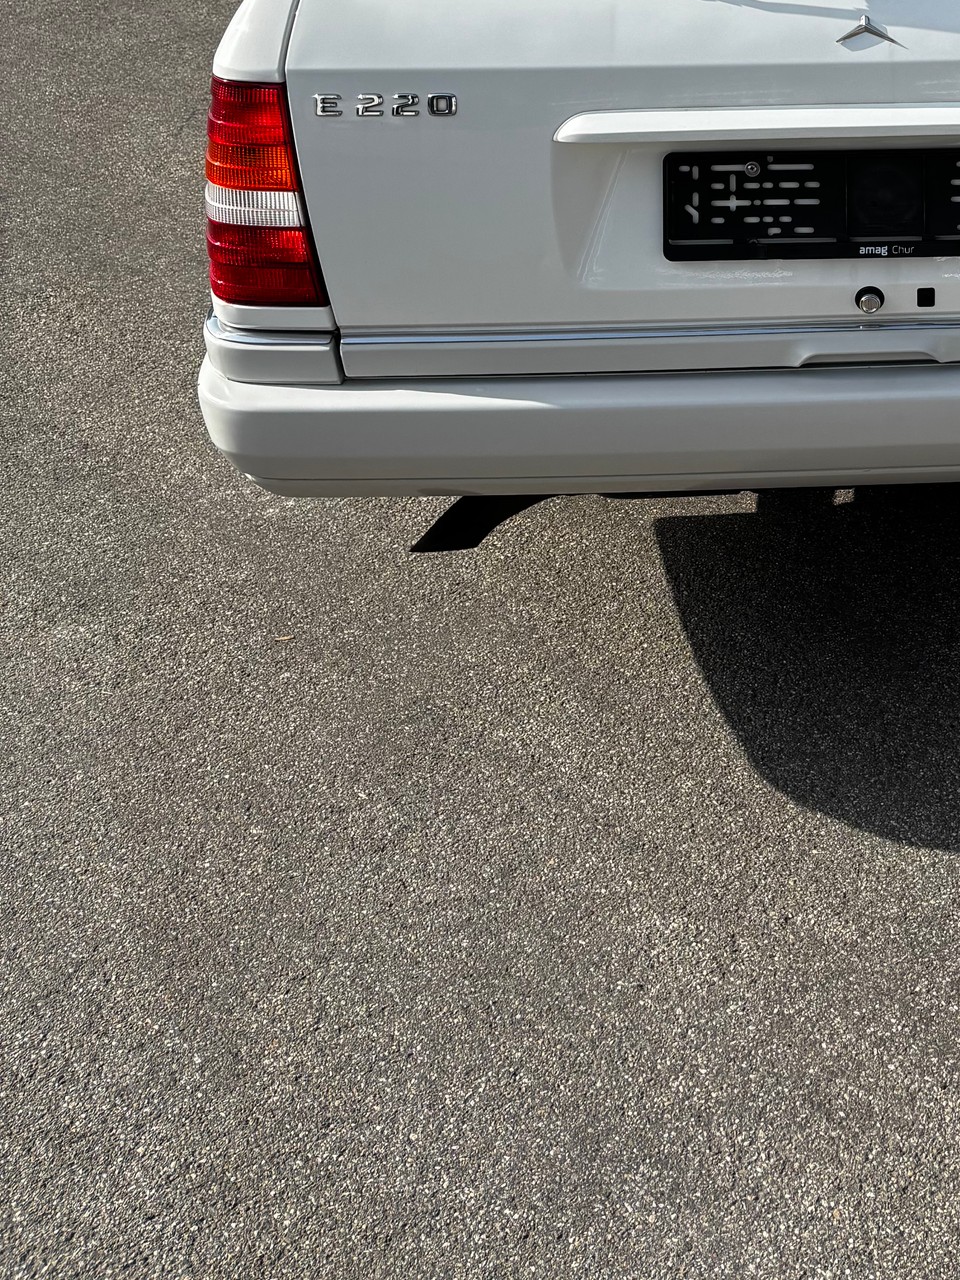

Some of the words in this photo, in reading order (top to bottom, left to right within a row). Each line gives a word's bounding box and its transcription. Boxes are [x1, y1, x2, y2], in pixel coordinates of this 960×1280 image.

[313, 93, 343, 117] E
[355, 93, 458, 117] 220
[859, 245, 888, 256] amag
[892, 245, 915, 254] Chur
